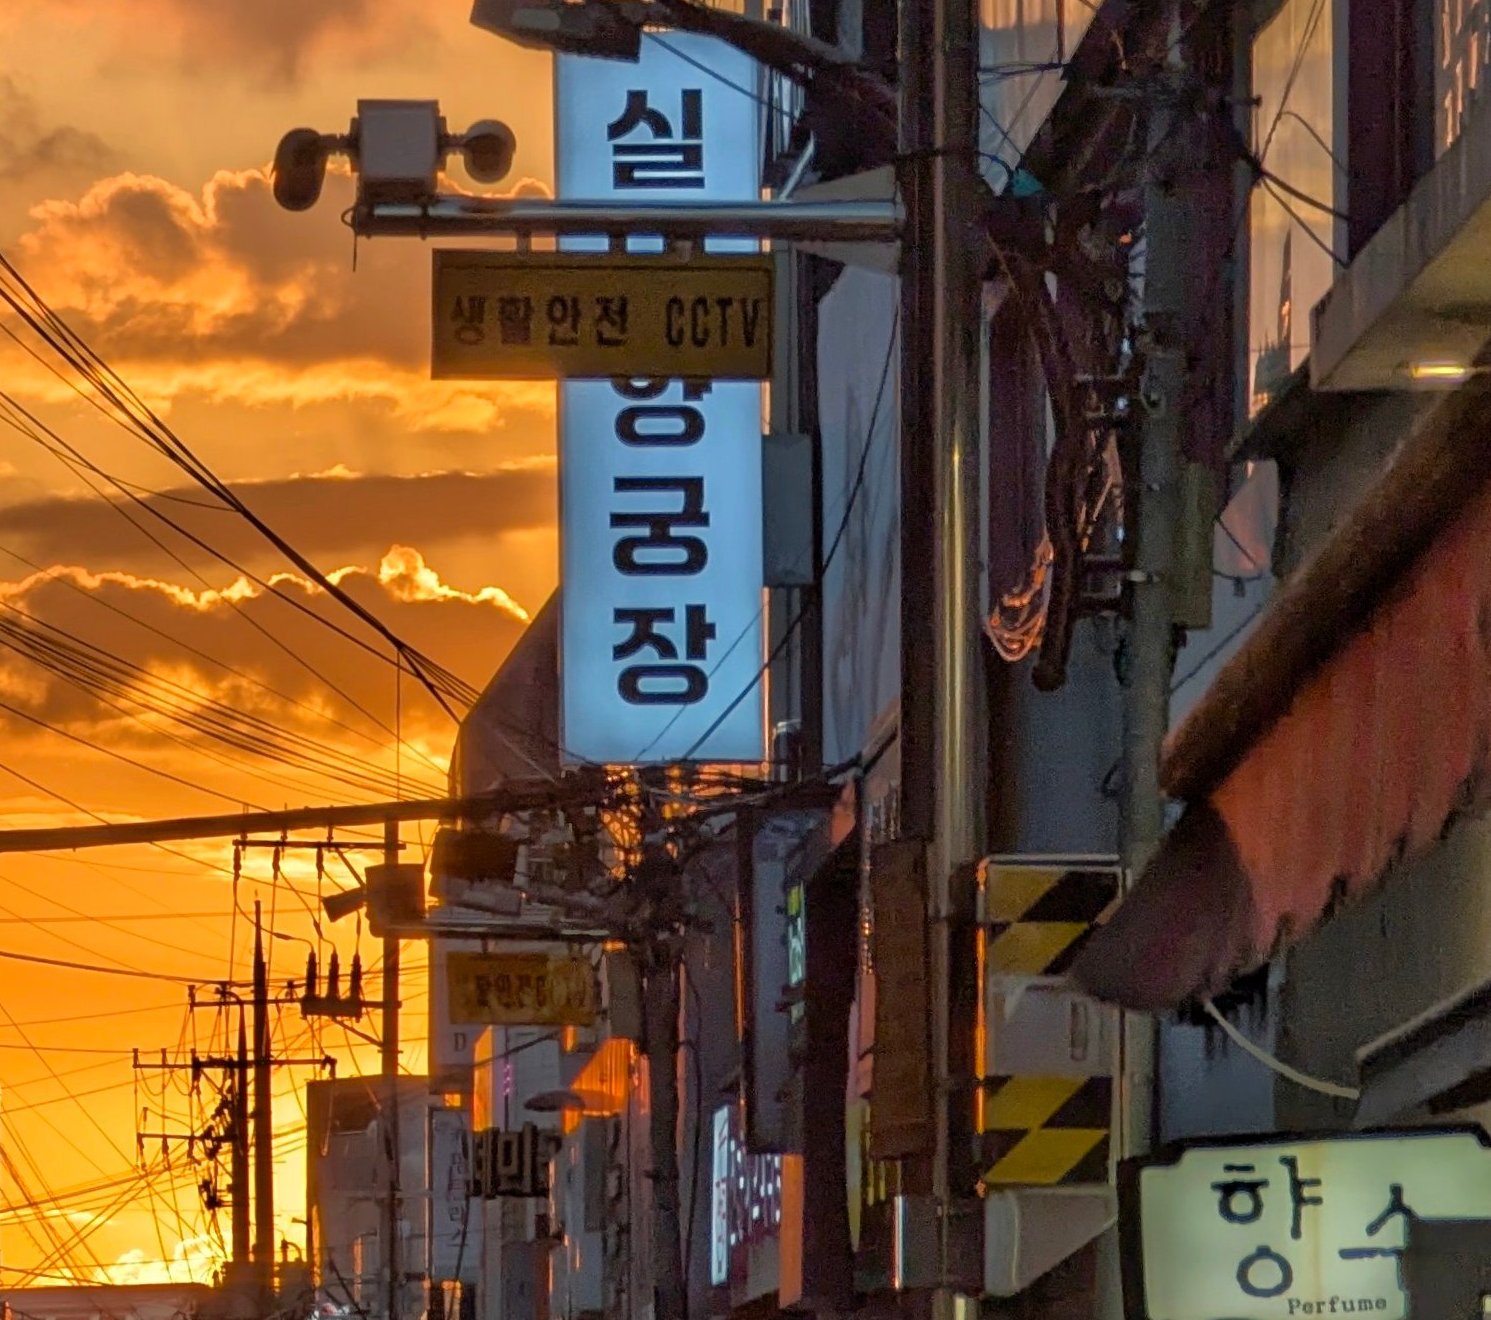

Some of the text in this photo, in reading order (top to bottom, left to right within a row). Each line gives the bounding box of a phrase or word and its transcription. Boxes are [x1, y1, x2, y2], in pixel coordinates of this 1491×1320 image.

[450, 295, 762, 349] 생활안전 CCTV
[607, 88, 715, 705] 실양궁장
[1288, 1295, 1387, 1315] Perfume
